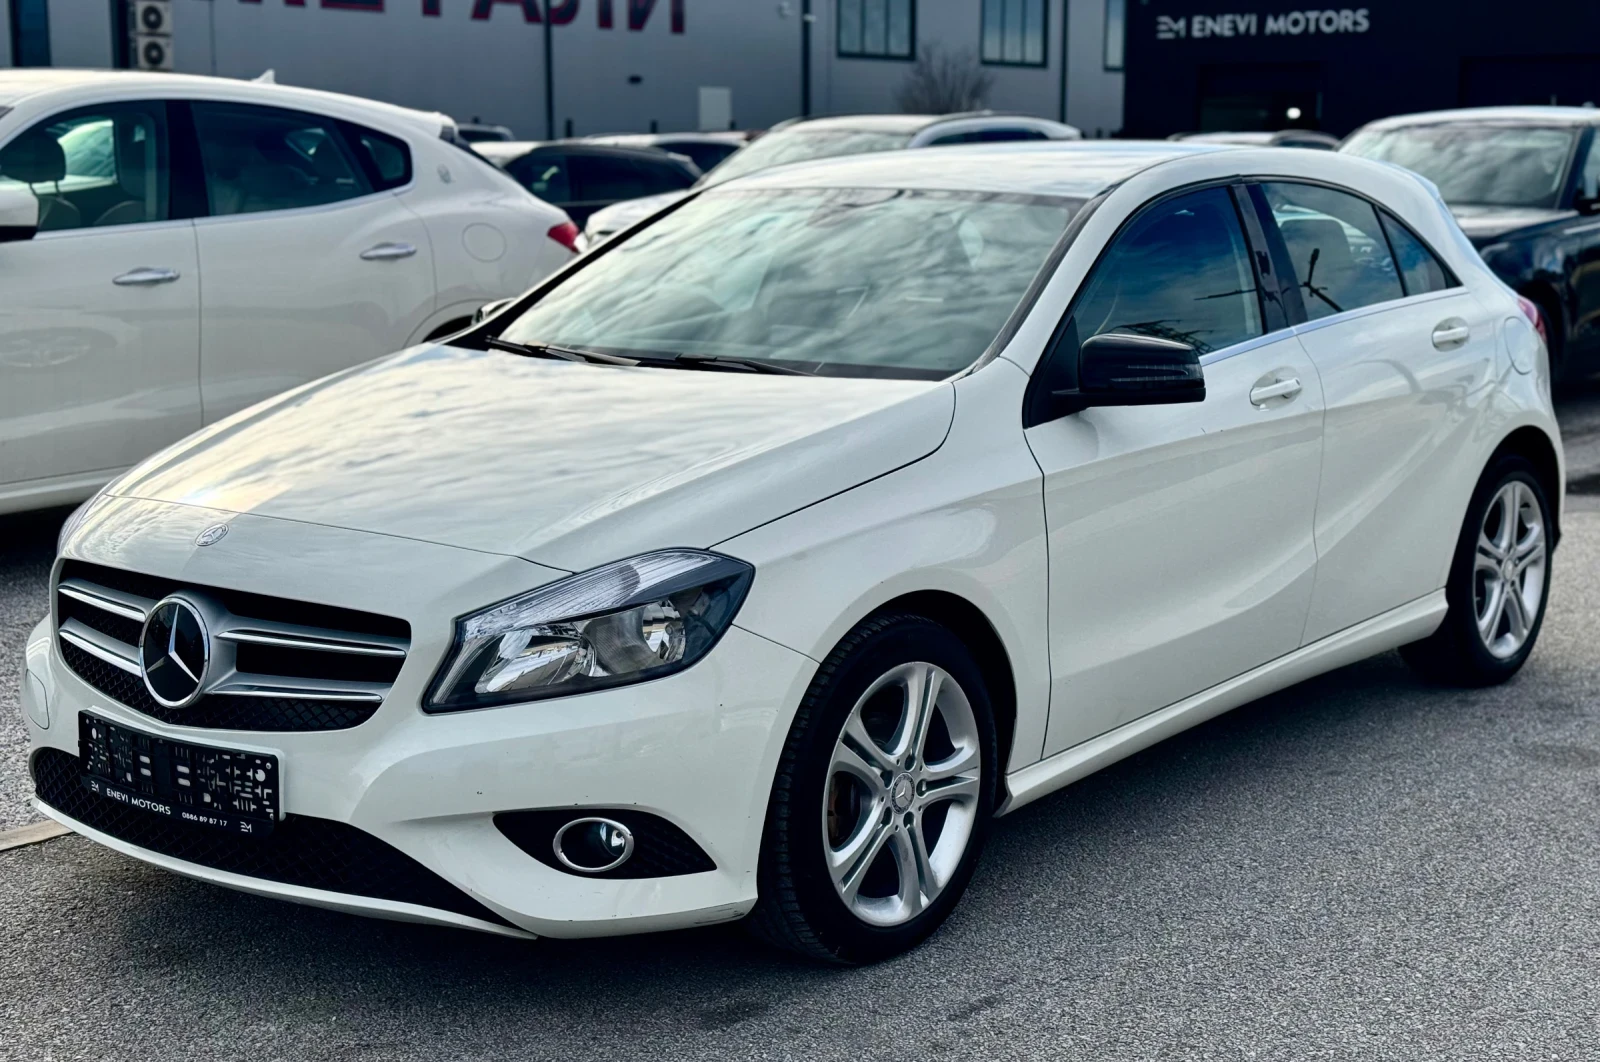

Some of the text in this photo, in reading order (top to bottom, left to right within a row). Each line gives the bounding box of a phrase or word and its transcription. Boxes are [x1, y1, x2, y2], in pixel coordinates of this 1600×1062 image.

[1192, 13, 1257, 38] ENEVI
[1264, 8, 1370, 36] MOTORS
[106, 788, 129, 803] ENEVI
[131, 796, 171, 815] MOTORS
[181, 811, 228, 827] 0886 89 87 17
